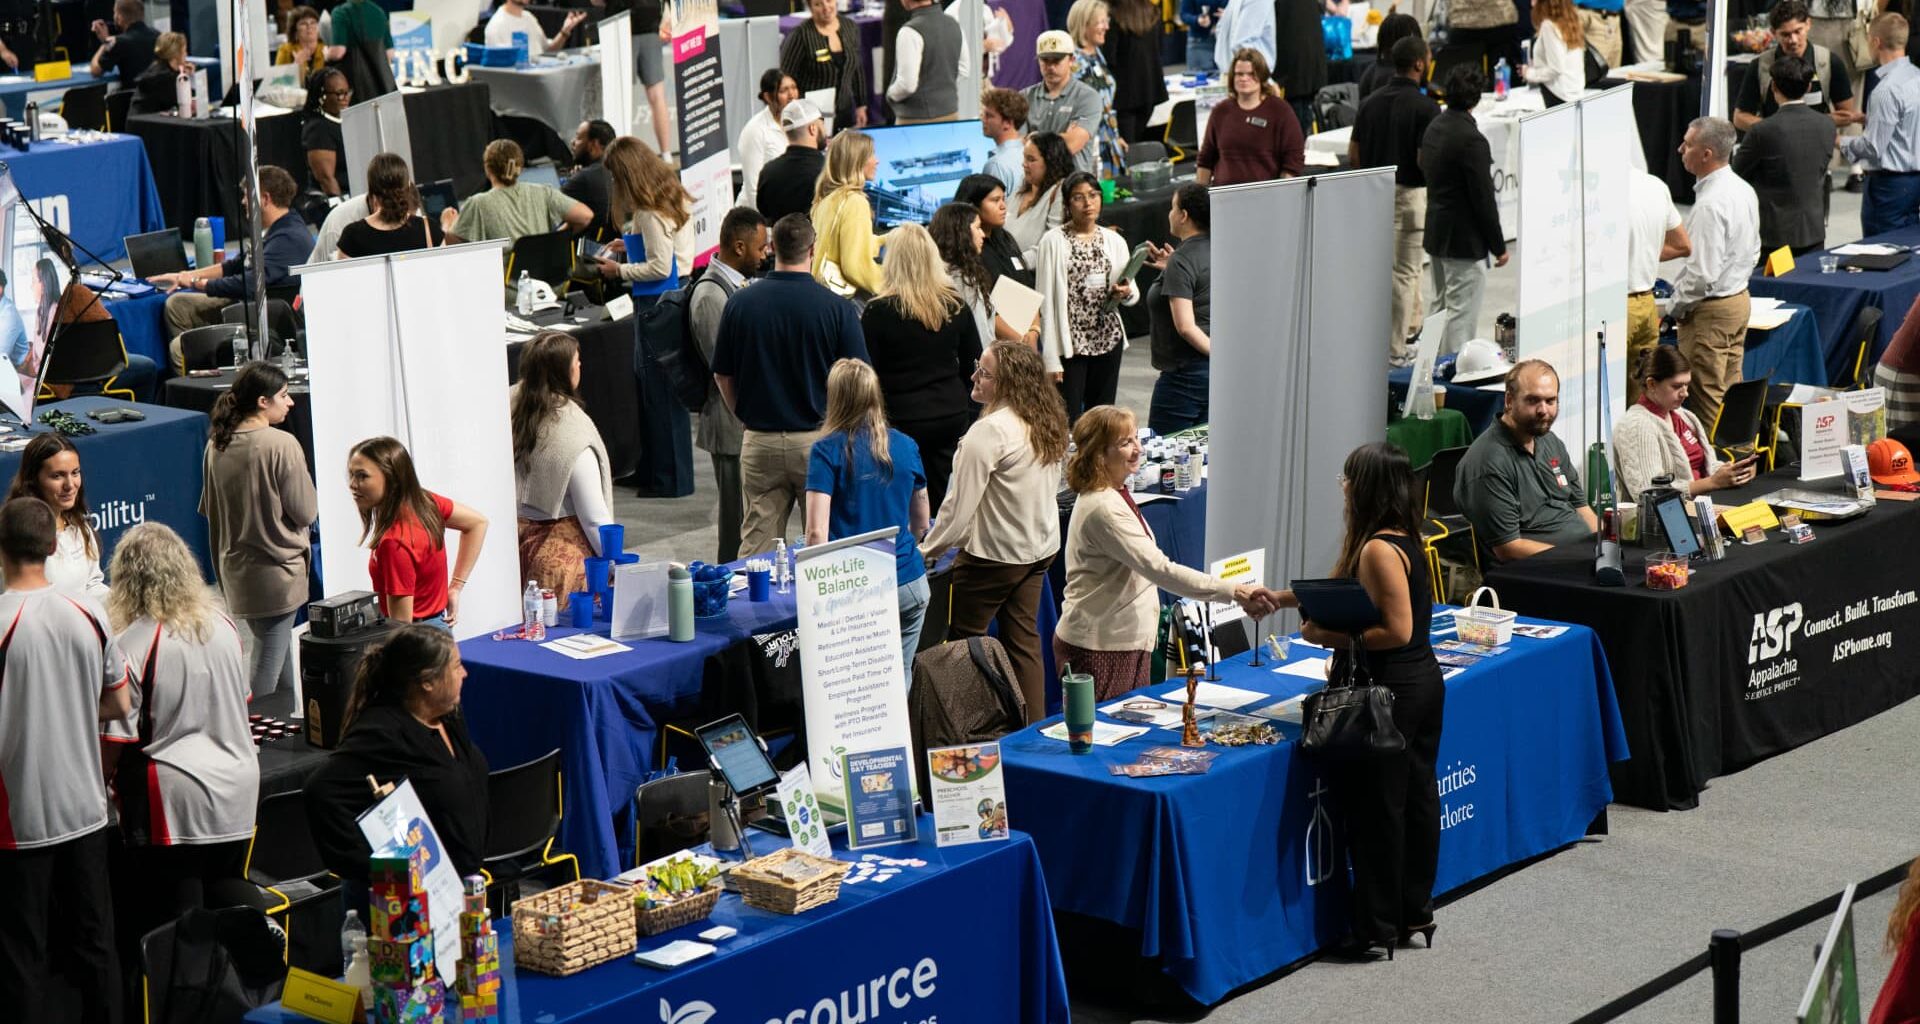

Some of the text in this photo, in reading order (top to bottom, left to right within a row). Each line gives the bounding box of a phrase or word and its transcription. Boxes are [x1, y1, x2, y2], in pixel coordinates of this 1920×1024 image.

[804, 558, 865, 581] Work-Life
[818, 575, 869, 596] Balance
[845, 611, 866, 624] Dental
[1804, 590, 1918, 638] Connect. Build. Transform.
[848, 620, 878, 632] Insurance
[1748, 602, 1804, 665] ASP
[818, 636, 850, 651] Retirement
[850, 634, 865, 643] Plan
[1832, 631, 1892, 662] ASPhome.org
[824, 643, 887, 663] Education Assistance
[868, 654, 894, 666] Disability
[822, 666, 892, 689] Generous Paid Time Off
[1748, 658, 1798, 690] Appalachia
[828, 681, 890, 700] Employee Assistance
[846, 694, 872, 705] Program
[834, 703, 887, 720] Wellness Program
[848, 717, 861, 726] PTO
[862, 712, 888, 722] Rewards
[842, 726, 882, 740] Pet Insurance
[849, 754, 903, 768] DEVELOPMENTAL
[851, 761, 897, 773] DAY TEACHERS
[764, 957, 938, 1024] ource
